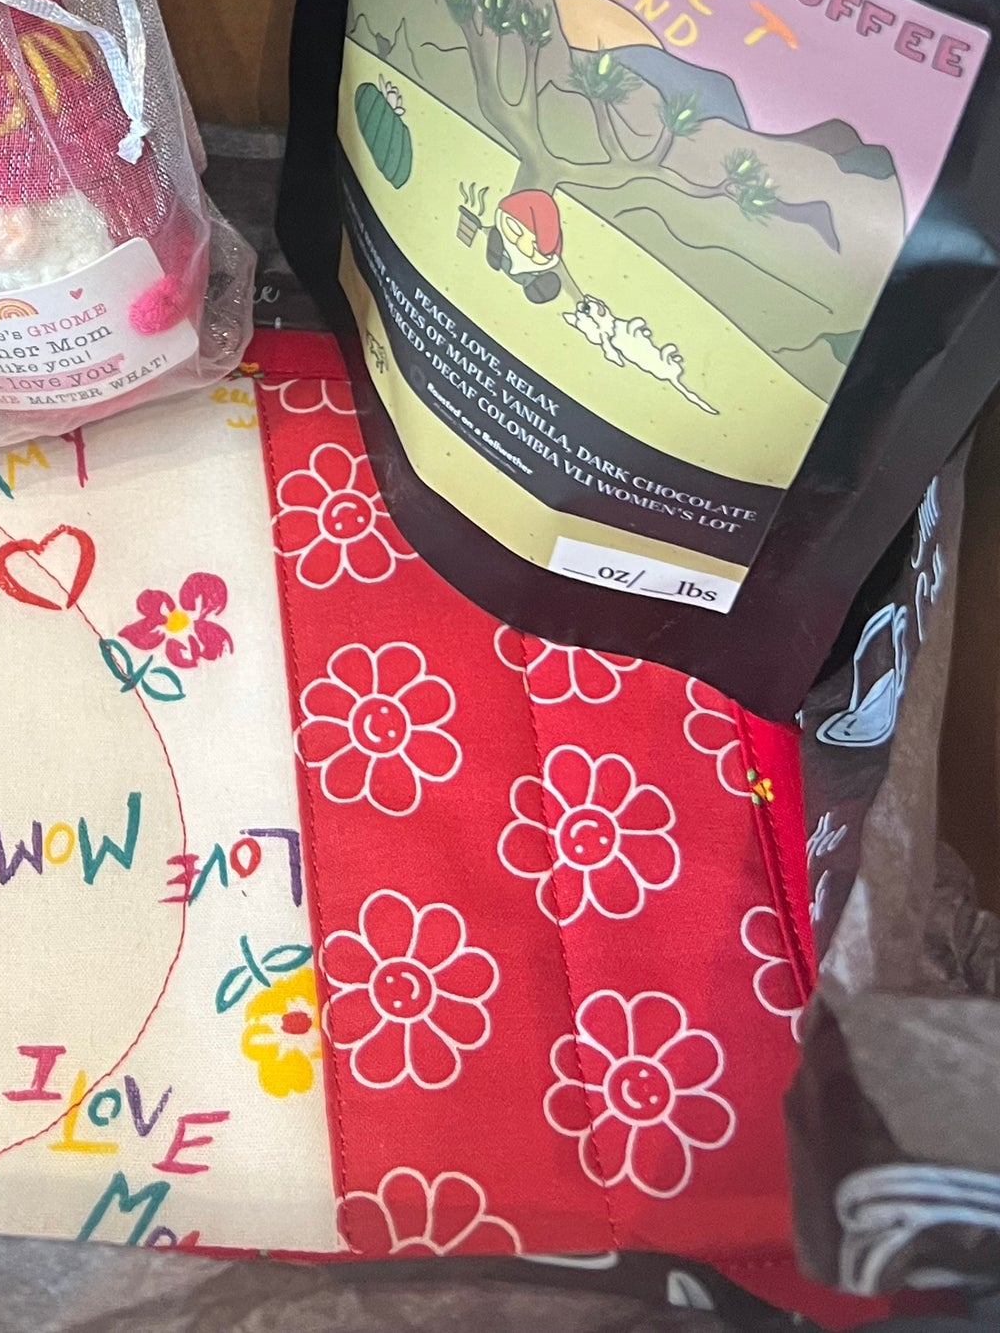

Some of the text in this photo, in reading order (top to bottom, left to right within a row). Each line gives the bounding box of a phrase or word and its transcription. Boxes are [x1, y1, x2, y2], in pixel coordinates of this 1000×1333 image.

[26, 303, 108, 339] GNOME
[46, 323, 113, 356] Mom
[10, 377, 62, 390] love
[70, 363, 118, 388] you
[42, 350, 93, 373] you!
[413, 287, 560, 418] PEACE, LOVE, RELAX
[26, 387, 104, 406] MATTER
[109, 354, 169, 390] WHAT!
[389, 279, 426, 330] NOTES
[425, 323, 447, 348] OF
[445, 343, 499, 398] MAPLE,
[500, 388, 573, 454] VANILLA,
[576, 445, 631, 484] DARK
[631, 475, 758, 522] CHOCOLATE
[427, 382, 462, 418] Roasted
[461, 416, 474, 429] on
[431, 353, 478, 401] DECAF
[477, 396, 560, 468] COLOMBIA
[563, 459, 594, 487] VLI
[595, 479, 695, 522] WOMEN'S
[697, 514, 742, 534] LOT
[2, 1044, 67, 1102] I
